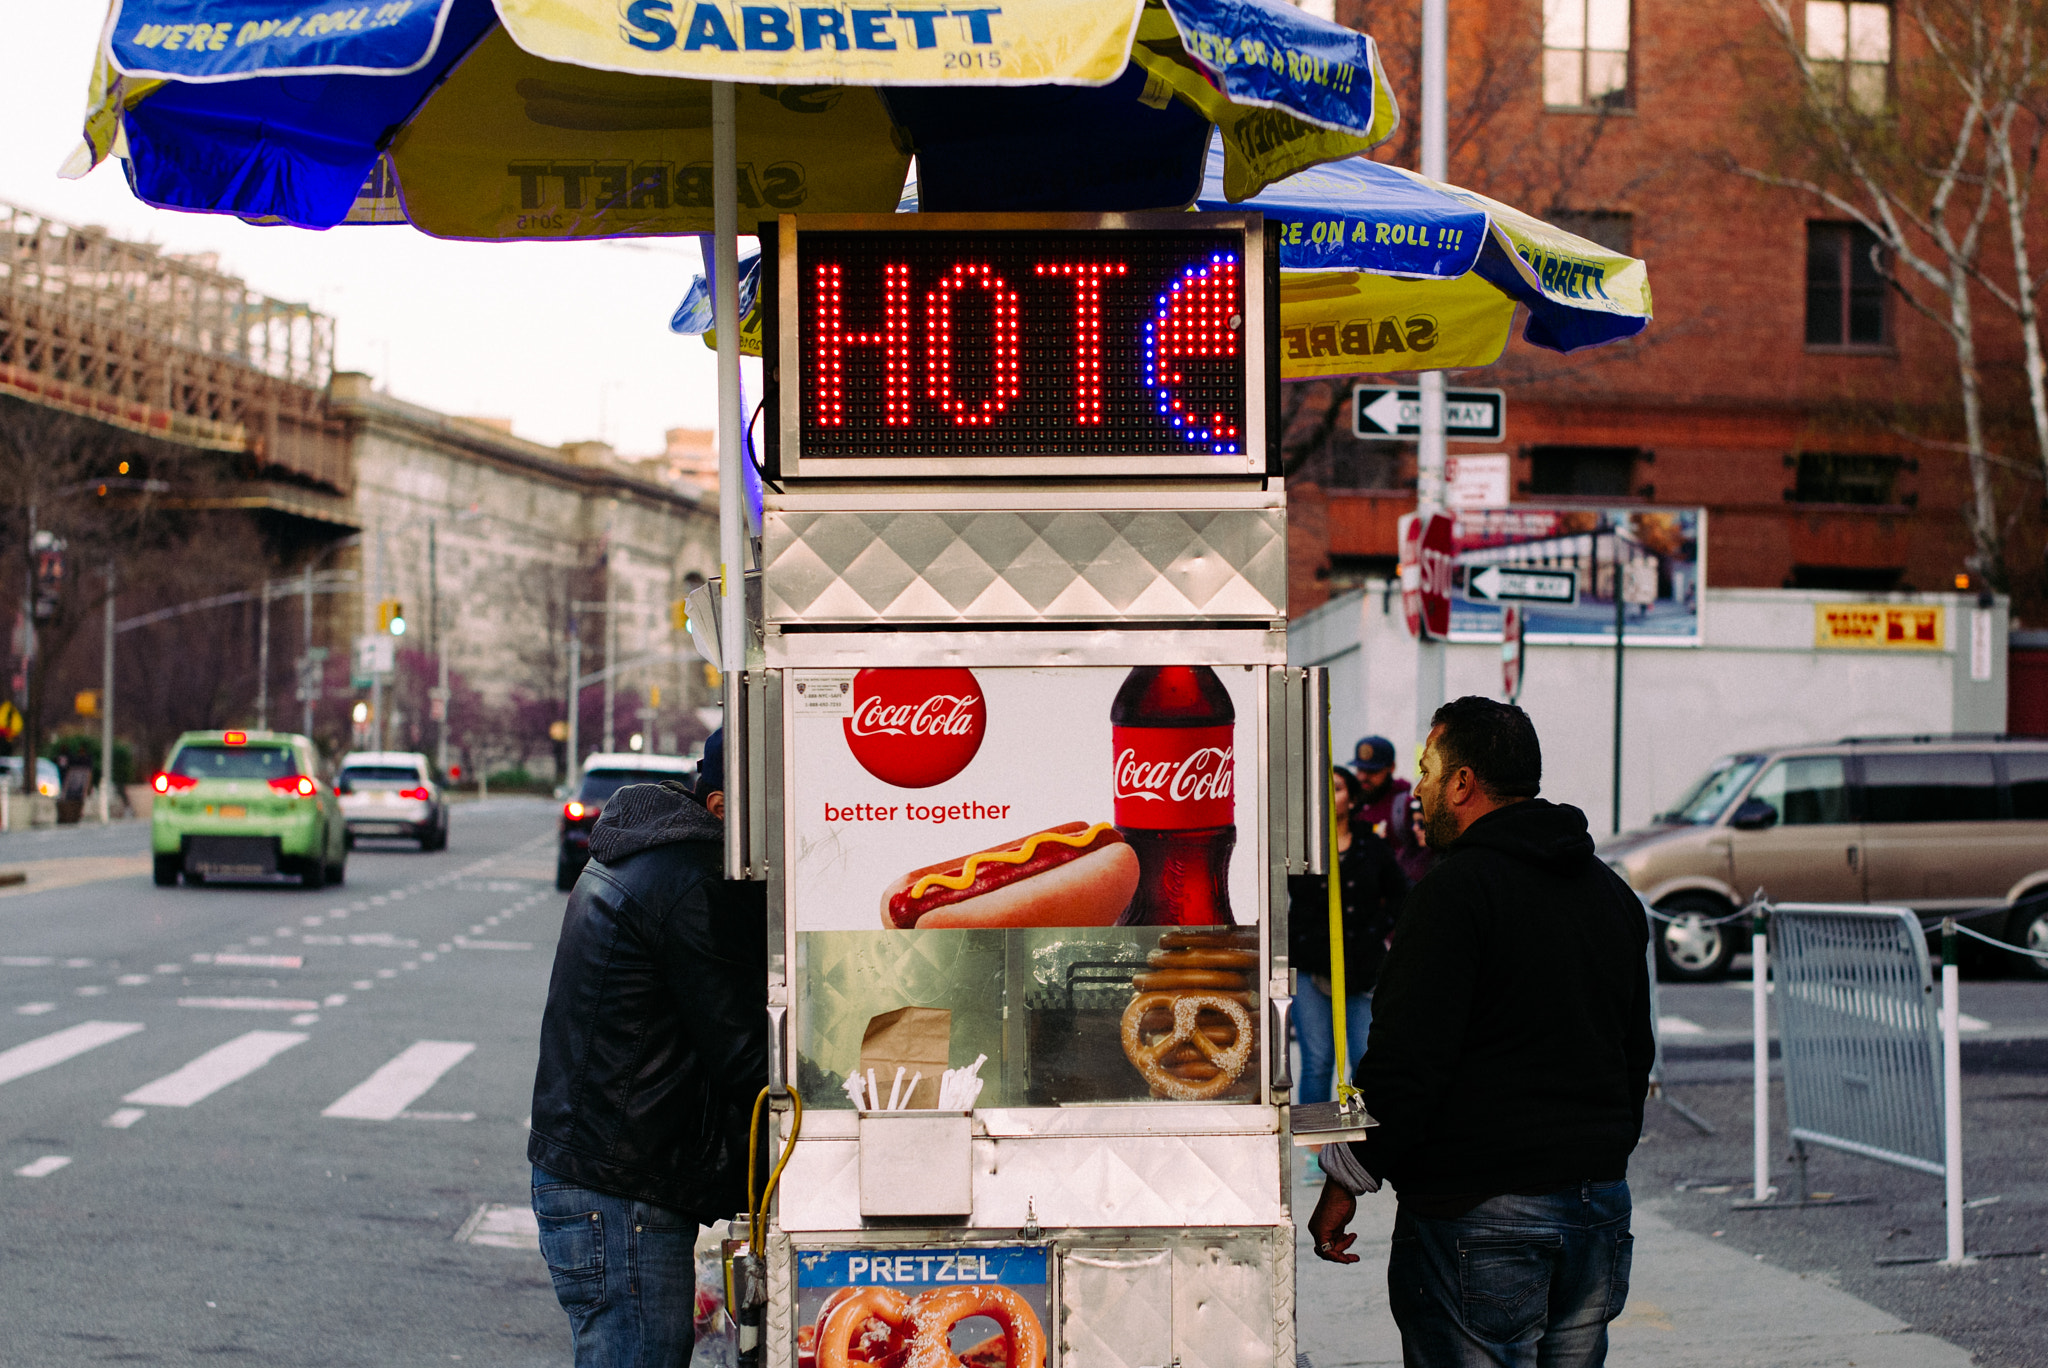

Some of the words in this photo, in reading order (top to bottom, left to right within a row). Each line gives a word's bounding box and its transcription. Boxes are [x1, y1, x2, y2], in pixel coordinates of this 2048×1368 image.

[132, 22, 233, 52] WE'RE
[235, 20, 281, 47] ON
[273, 17, 303, 38] A
[298, 7, 370, 37] ROLL
[618, 0, 1003, 52] SABRETT
[943, 51, 1003, 69] 2015
[1240, 39, 1269, 66] ON
[1272, 47, 1285, 75] A
[1286, 49, 1329, 87] ROLL
[1311, 220, 1345, 244] ON
[1352, 221, 1366, 243] A
[1374, 222, 1430, 247] ROLL
[1437, 228, 1463, 251] !!!
[815, 262, 1130, 427] HOT
[852, 695, 979, 736] Coca-Cola
[1115, 746, 1233, 801] Coca-Cola
[825, 803, 898, 821] better
[906, 800, 1010, 824] together
[848, 1255, 999, 1283] PRETZEL
